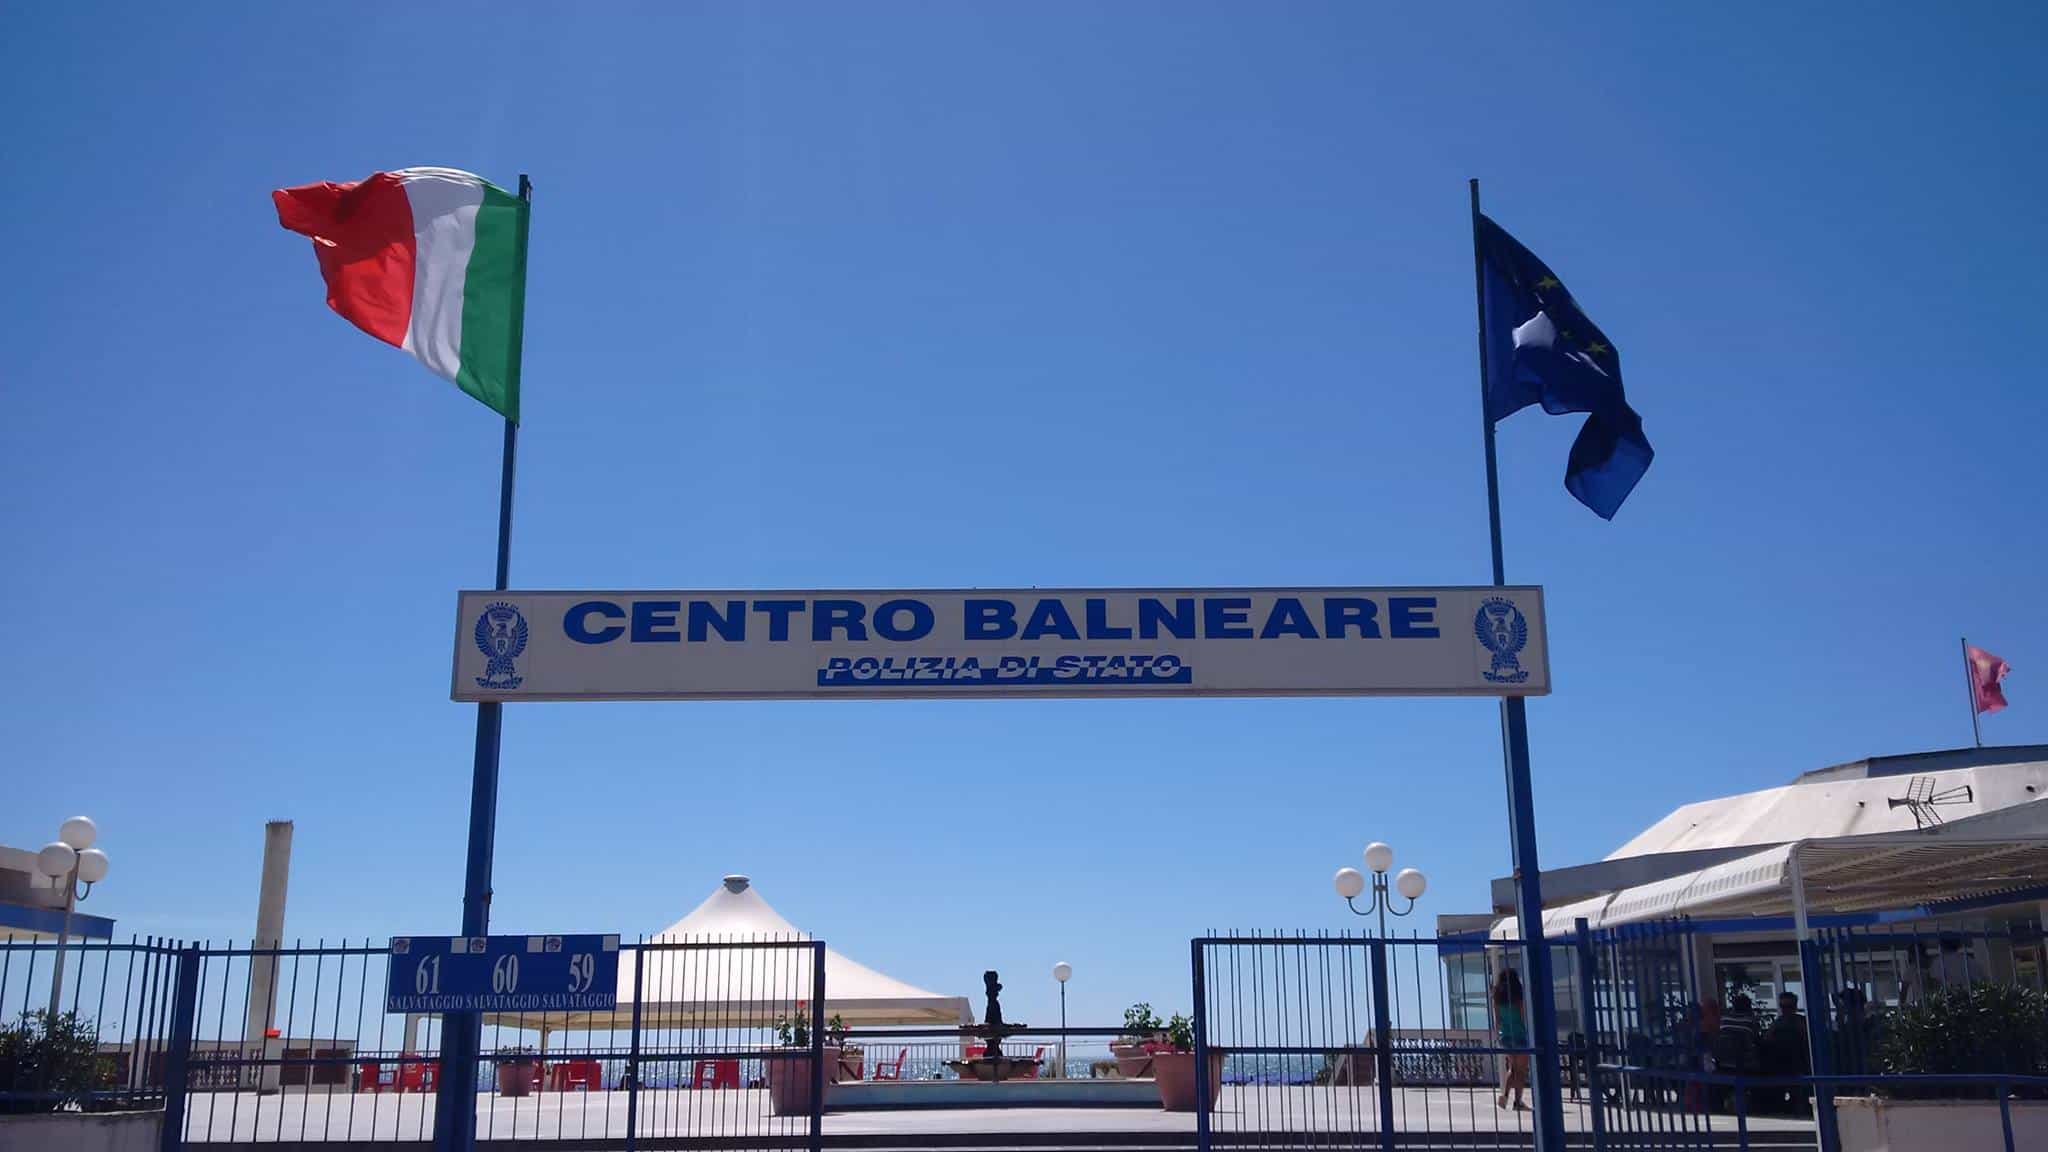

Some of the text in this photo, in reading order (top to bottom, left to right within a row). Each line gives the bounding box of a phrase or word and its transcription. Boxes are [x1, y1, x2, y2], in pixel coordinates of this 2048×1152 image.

[564, 596, 1440, 645] CENTRO BALNEARE
[825, 654, 1181, 680] POLIZIA DI STATO
[415, 955, 441, 994] 61
[492, 954, 519, 994] 60
[568, 953, 595, 993] 59
[389, 996, 463, 1010] SALVATAGGIO
[466, 995, 540, 1010] SALVATAGGIO
[543, 994, 616, 1008] SALVATAGGIO
